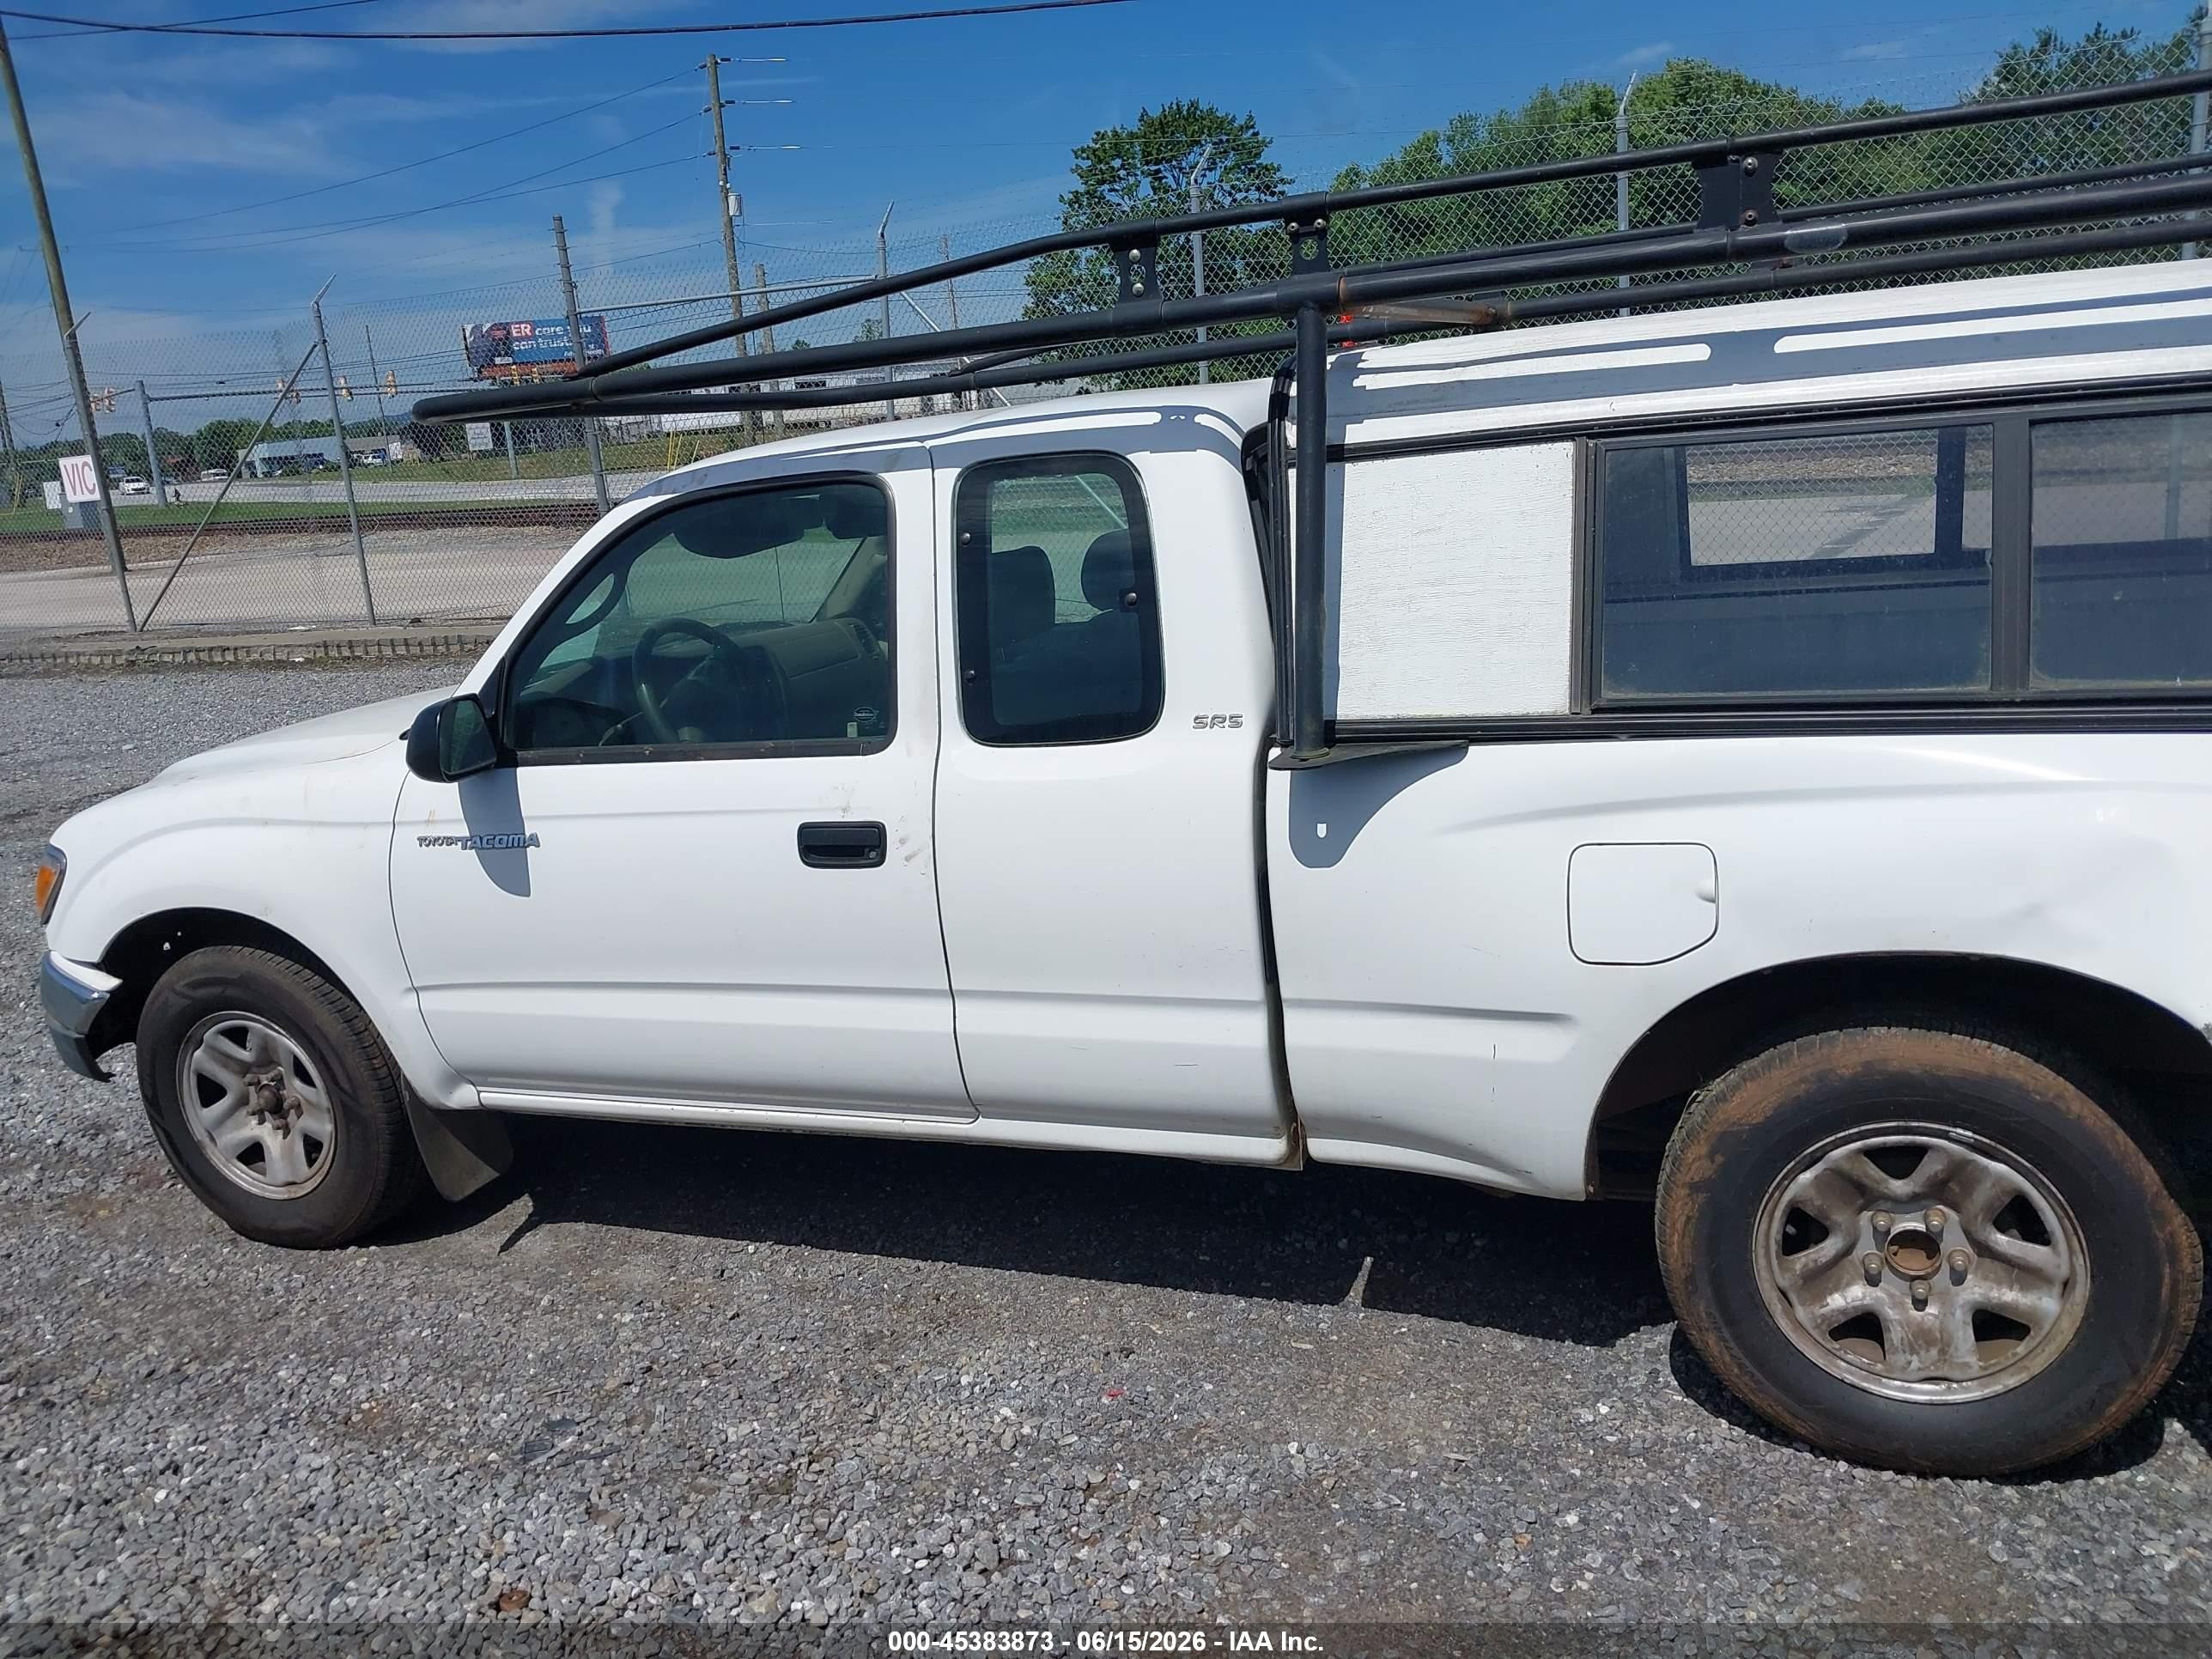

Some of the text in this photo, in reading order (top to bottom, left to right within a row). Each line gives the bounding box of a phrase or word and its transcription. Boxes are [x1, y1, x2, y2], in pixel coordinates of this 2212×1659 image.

[511, 324, 532, 337] ER
[535, 325, 564, 336] care
[513, 336, 573, 350] can trust
[64, 460, 96, 495] VIC
[416, 832, 541, 851] TOYOTA TACOMA
